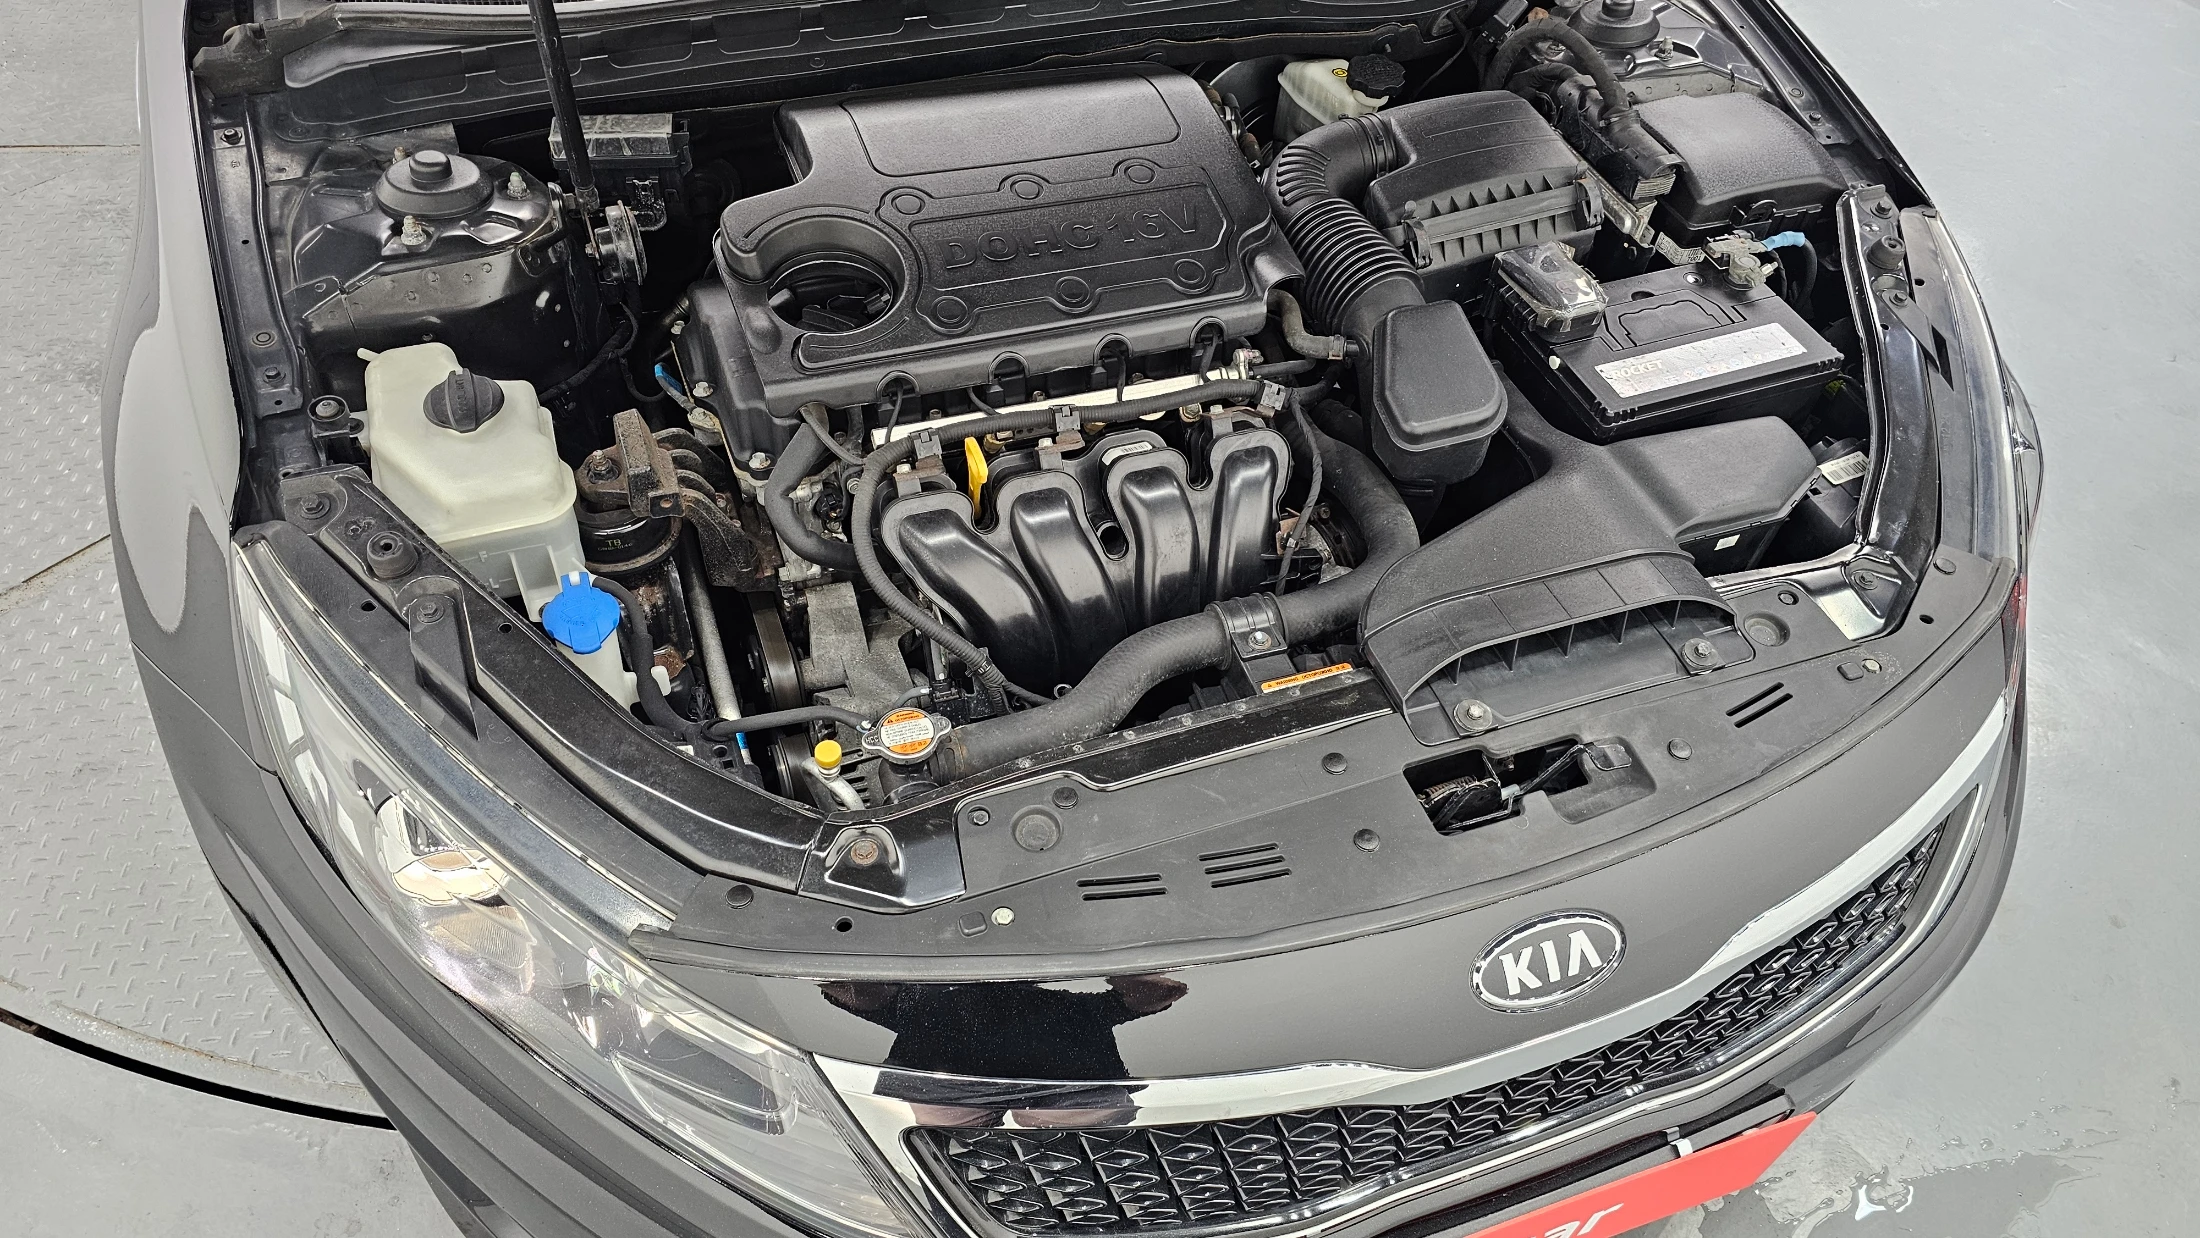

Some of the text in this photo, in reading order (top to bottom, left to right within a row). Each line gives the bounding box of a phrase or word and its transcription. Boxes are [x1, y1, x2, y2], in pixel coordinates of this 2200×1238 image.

[938, 203, 1197, 269] DOHC 16V
[1611, 360, 1663, 378] ROCKET
[1498, 929, 1603, 996] KIA
